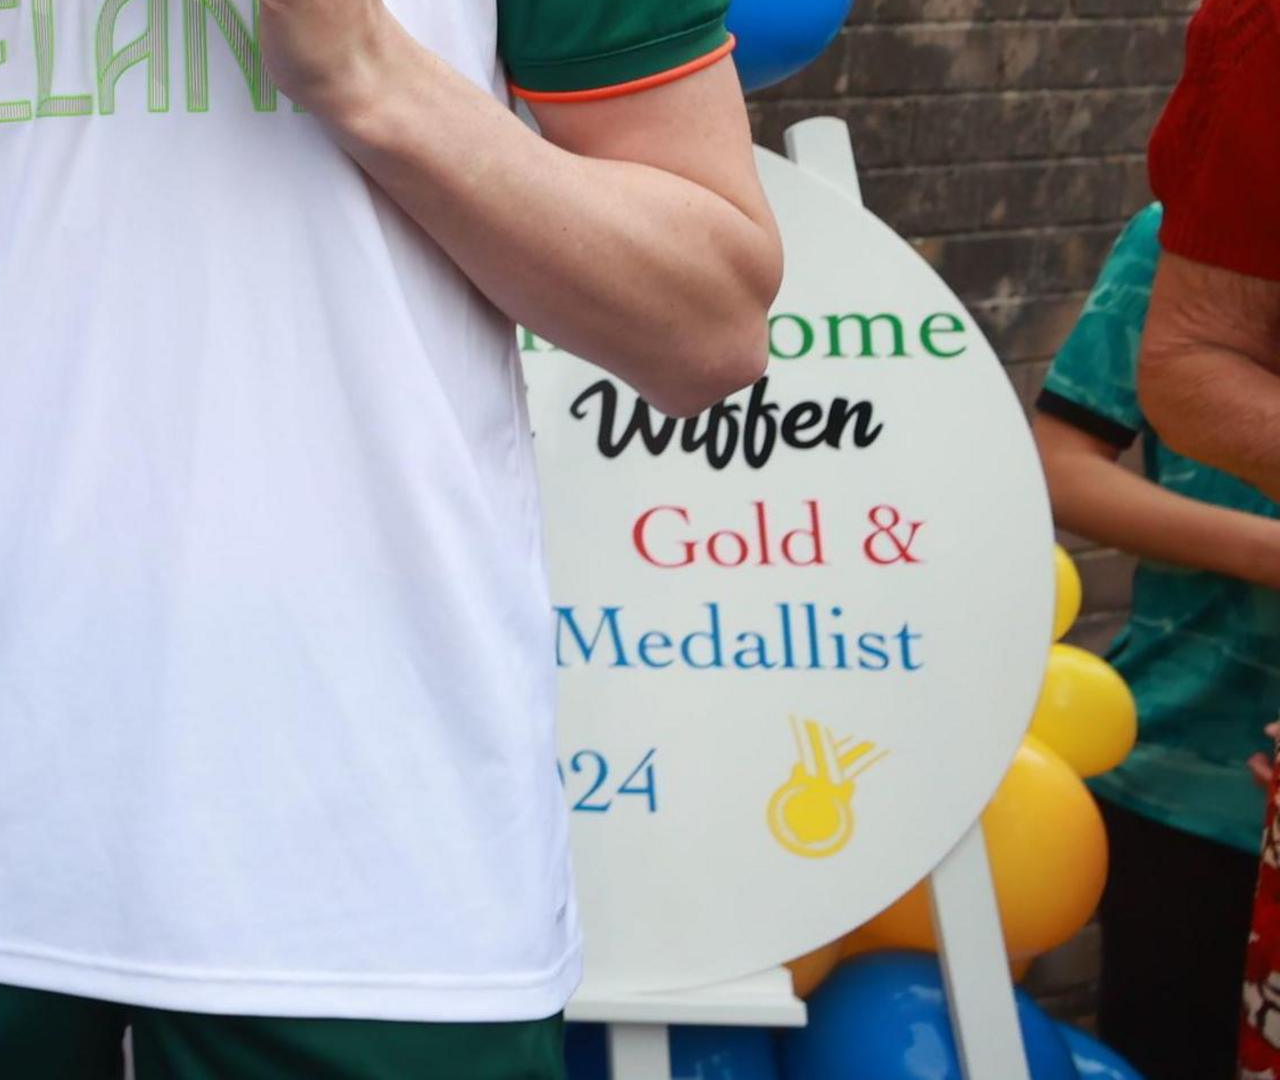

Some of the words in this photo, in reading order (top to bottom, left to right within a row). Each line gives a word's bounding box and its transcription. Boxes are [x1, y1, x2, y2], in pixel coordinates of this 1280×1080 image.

[769, 312, 967, 359] ome
[632, 499, 831, 569] Gold
[862, 503, 927, 566] &
[552, 602, 925, 671] Medallist
[556, 747, 658, 814] 24
